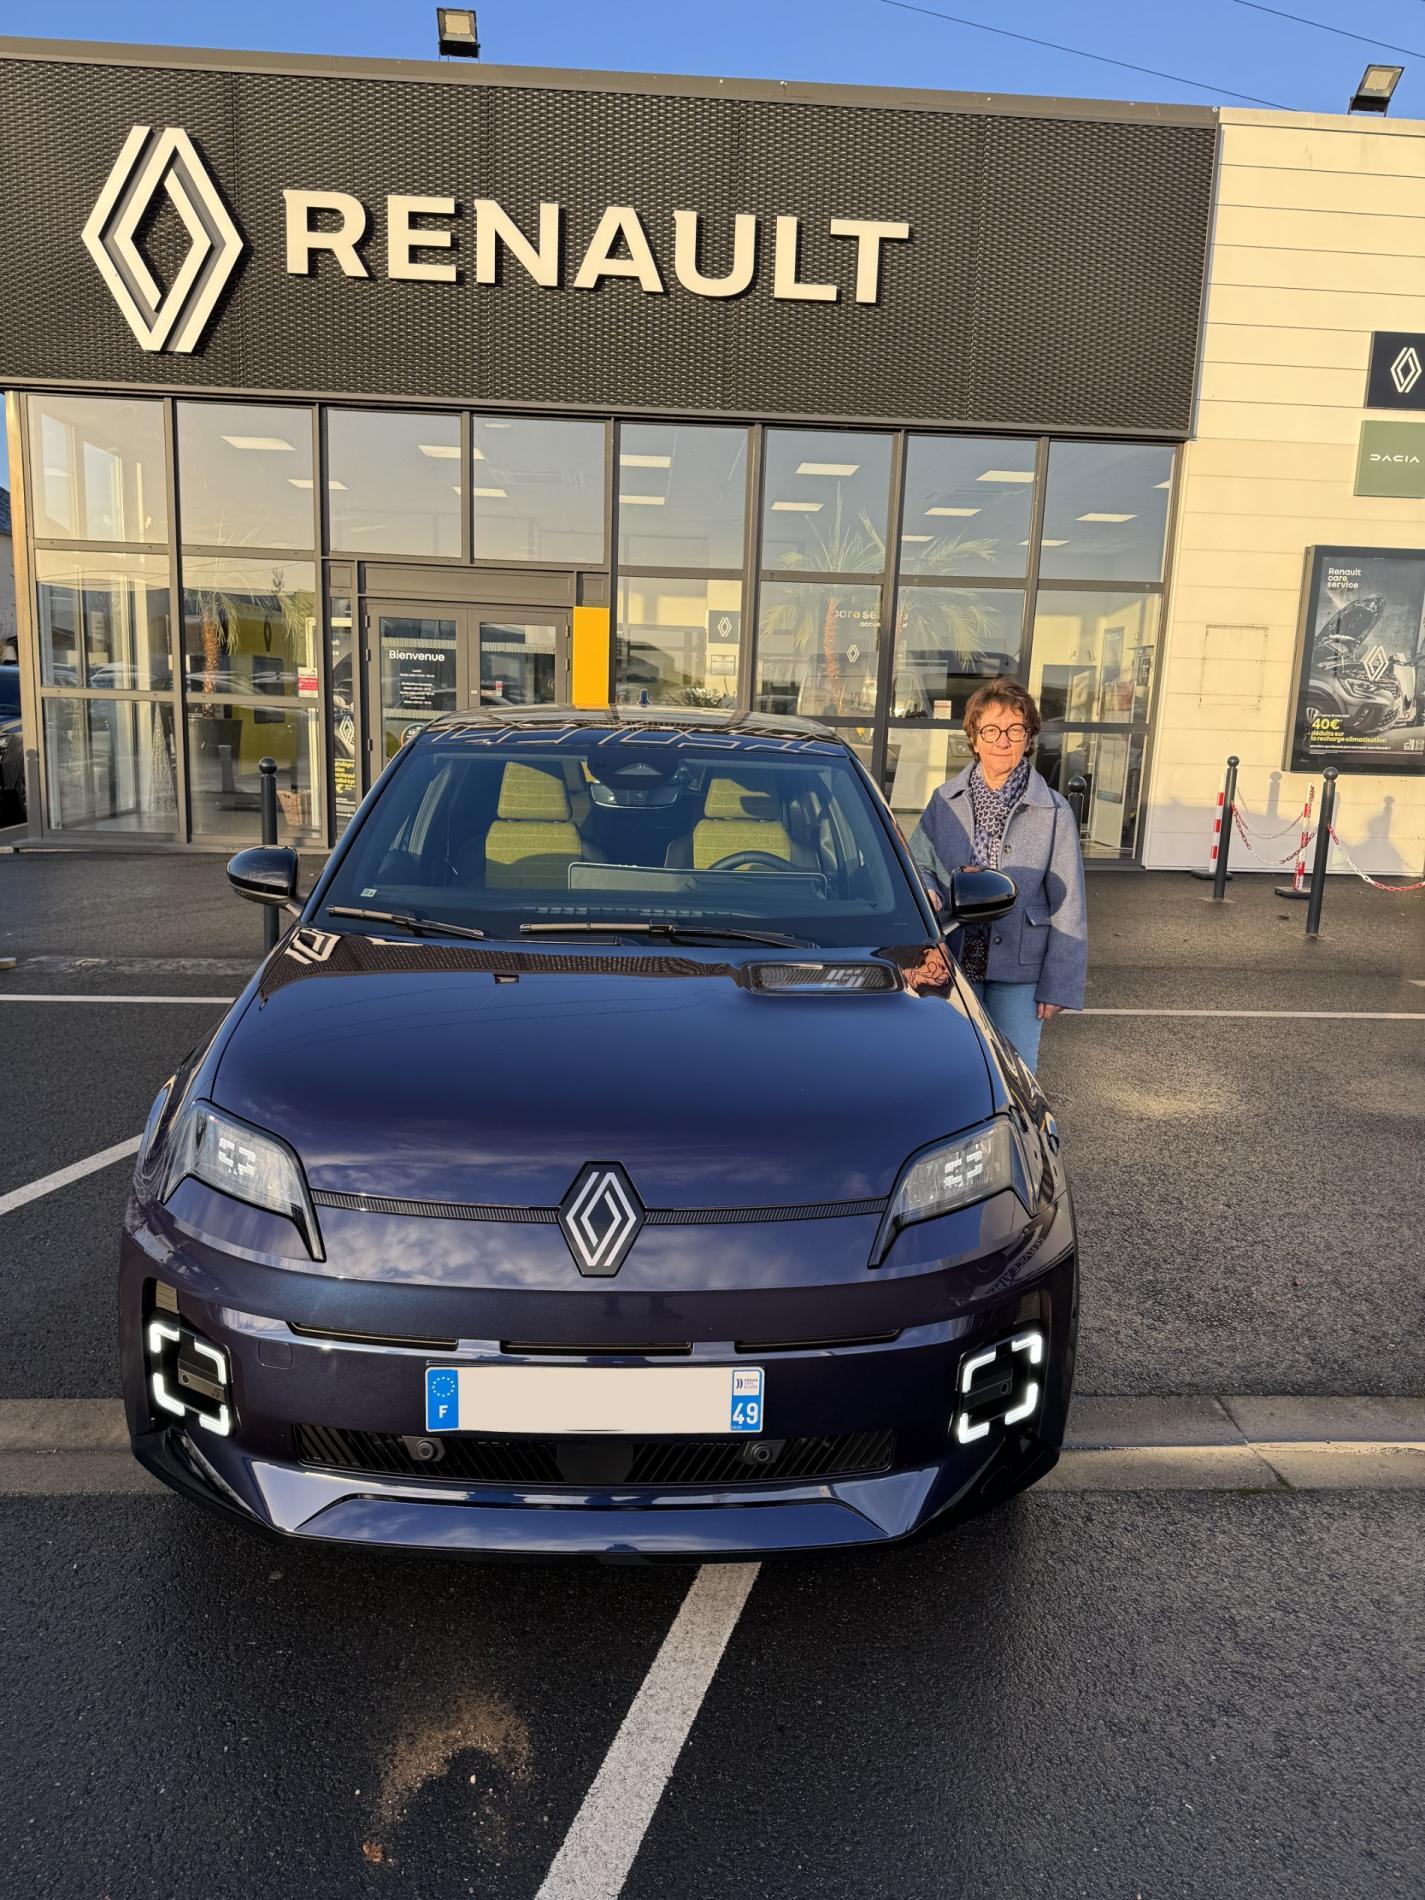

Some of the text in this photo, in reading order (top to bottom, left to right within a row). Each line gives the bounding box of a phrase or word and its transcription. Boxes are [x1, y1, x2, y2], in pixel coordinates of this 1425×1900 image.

[282, 188, 910, 303] RENAULT
[1370, 454, 1420, 463] DACIA
[1328, 568, 1362, 576] Renault
[1327, 581, 1359, 589] service
[389, 650, 445, 662] Bienvenue
[439, 1405, 448, 1418] F
[732, 1402, 759, 1425] 49
